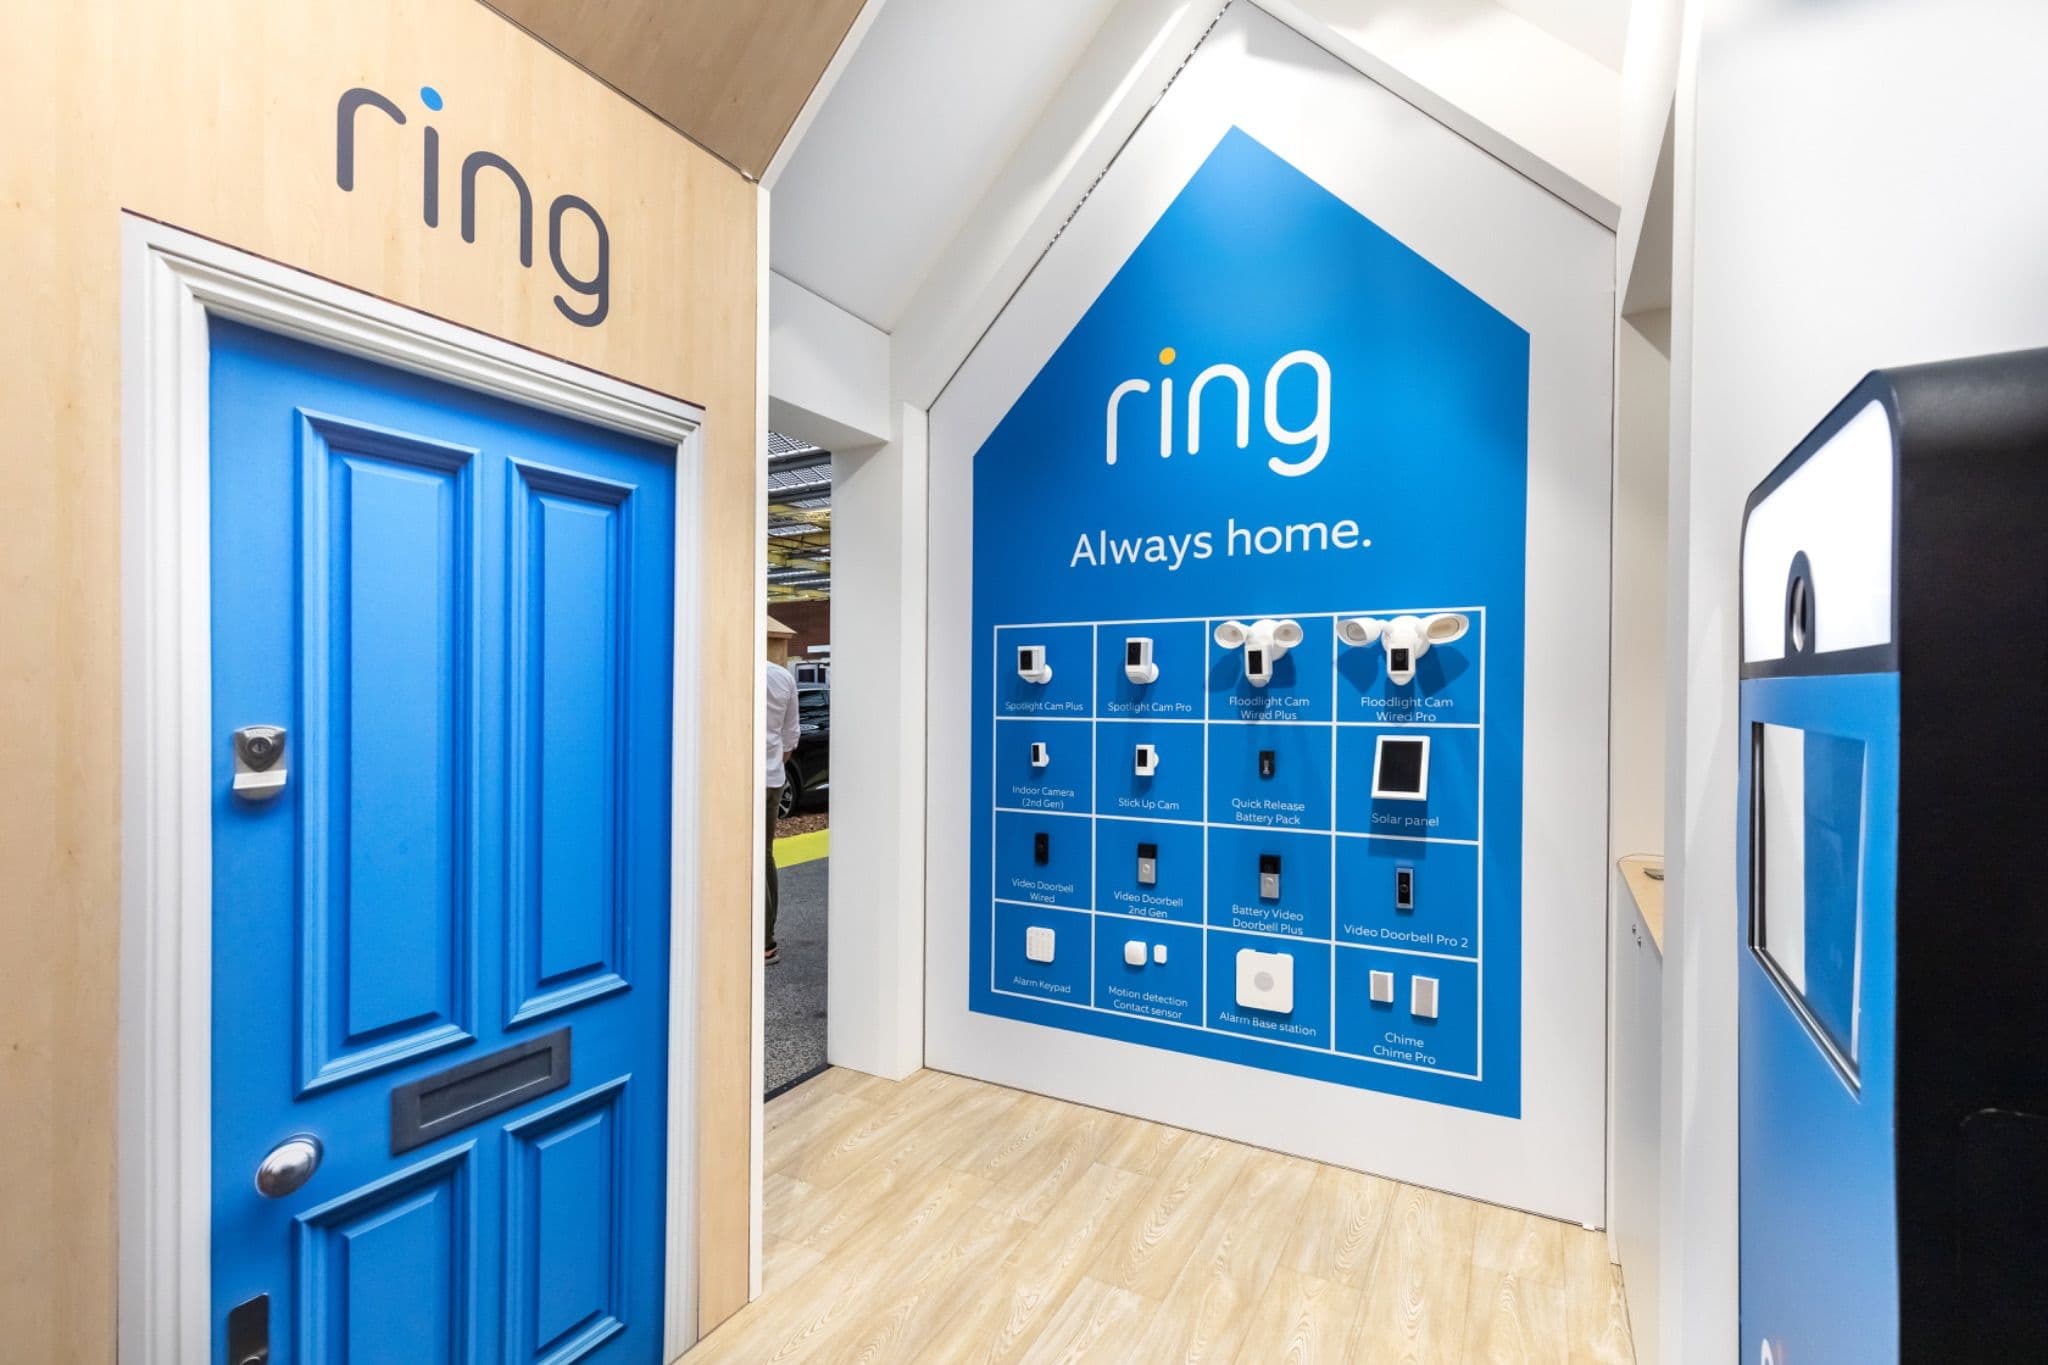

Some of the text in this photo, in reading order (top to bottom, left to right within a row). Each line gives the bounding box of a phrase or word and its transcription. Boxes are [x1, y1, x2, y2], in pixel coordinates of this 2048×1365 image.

[336, 85, 610, 328] ring
[1106, 347, 1332, 477] ring
[1070, 518, 1372, 571] Always home.
[1005, 701, 1084, 712] Spotlight Cam Plus
[1107, 702, 1192, 714] Spotlight Cam Pro
[1229, 696, 1310, 708] Floodlight Cam
[1361, 697, 1453, 709] Floodlight Cam
[1241, 710, 1297, 720] Wired Plus
[1376, 711, 1437, 722] Wired Pro
[1012, 785, 1075, 797] Indoor Camera
[1022, 797, 1064, 809] (2nd Gen)
[1118, 797, 1179, 811] Stick Up Cam
[1232, 798, 1305, 811] Quick Release
[1236, 812, 1300, 825] Battery Pack
[1371, 812, 1439, 828] Solar panel
[1012, 878, 1073, 893] Video Doorbell
[1030, 892, 1055, 903] Wired
[1114, 890, 1183, 907] Video Doorbell
[1128, 905, 1168, 918] 2nd Gen
[1232, 904, 1304, 921] Battery Video
[1232, 918, 1304, 935] Doorbell Plus
[1344, 924, 1469, 948] Video Doorbell Pro 2
[1013, 975, 1071, 994] Alarm Keypad
[1108, 986, 1188, 1007] Motion detection
[1113, 999, 1182, 1019] Contact sensor
[1219, 1012, 1317, 1037] Alarm Base station
[1384, 1032, 1425, 1048] Chime
[1373, 1045, 1437, 1065] Chime Pro
